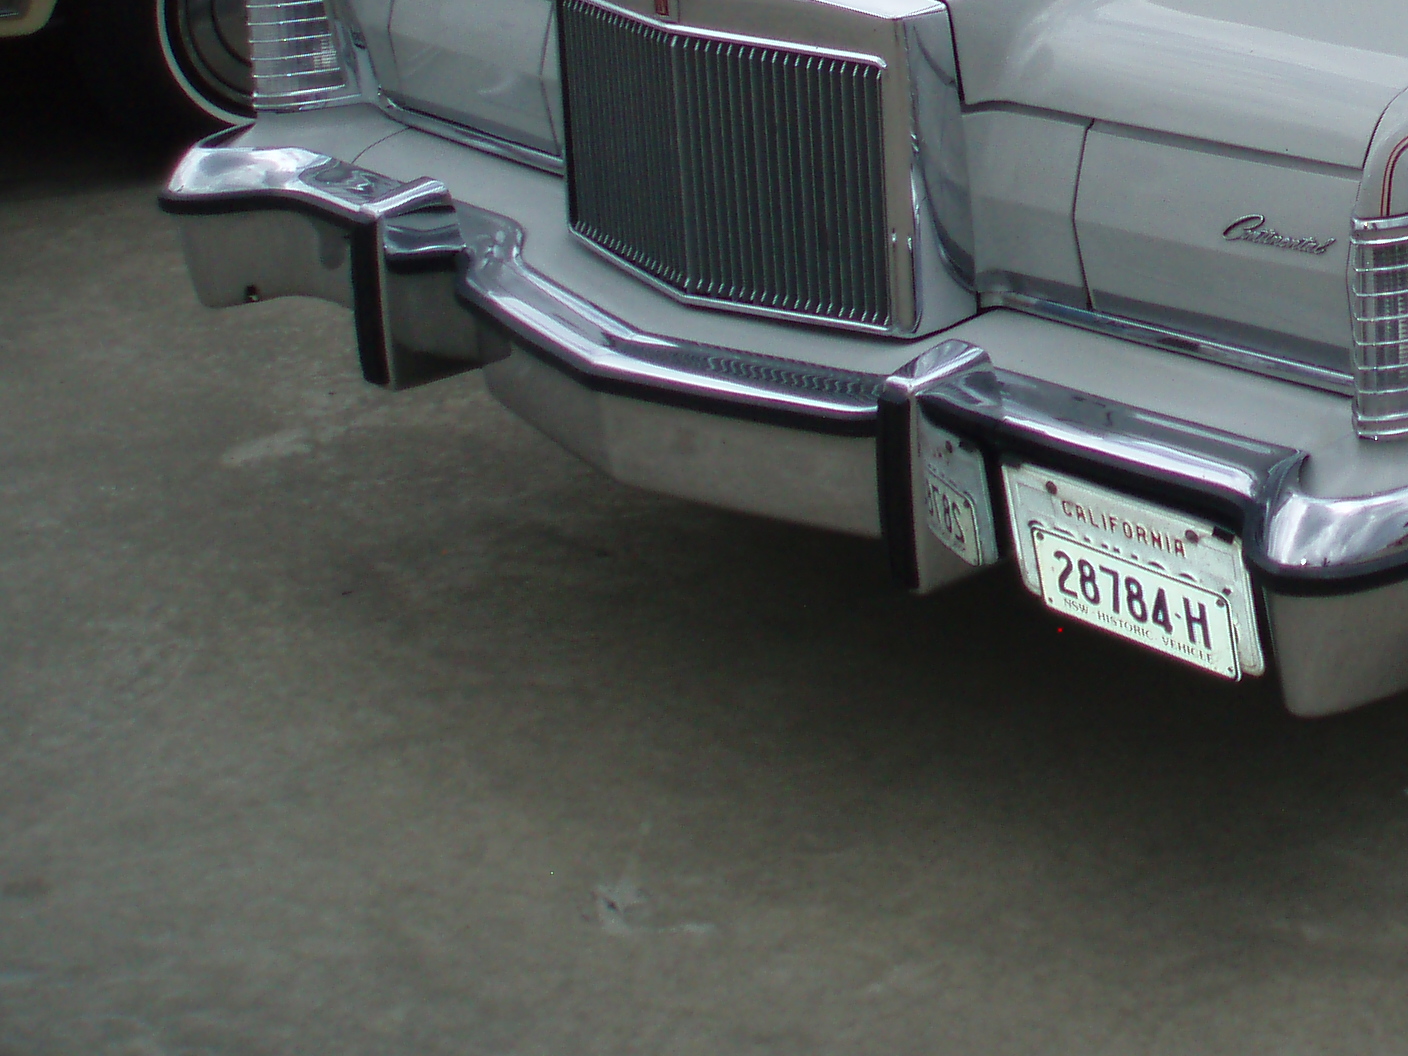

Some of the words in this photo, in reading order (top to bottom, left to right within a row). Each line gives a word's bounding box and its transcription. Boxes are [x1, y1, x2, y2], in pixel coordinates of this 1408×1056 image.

[1062, 500, 1186, 558] CALIFORNIA
[1063, 597, 1089, 614] NSW
[1097, 610, 1154, 641] HISTORIC
[1161, 636, 1213, 663] VEHICLE
